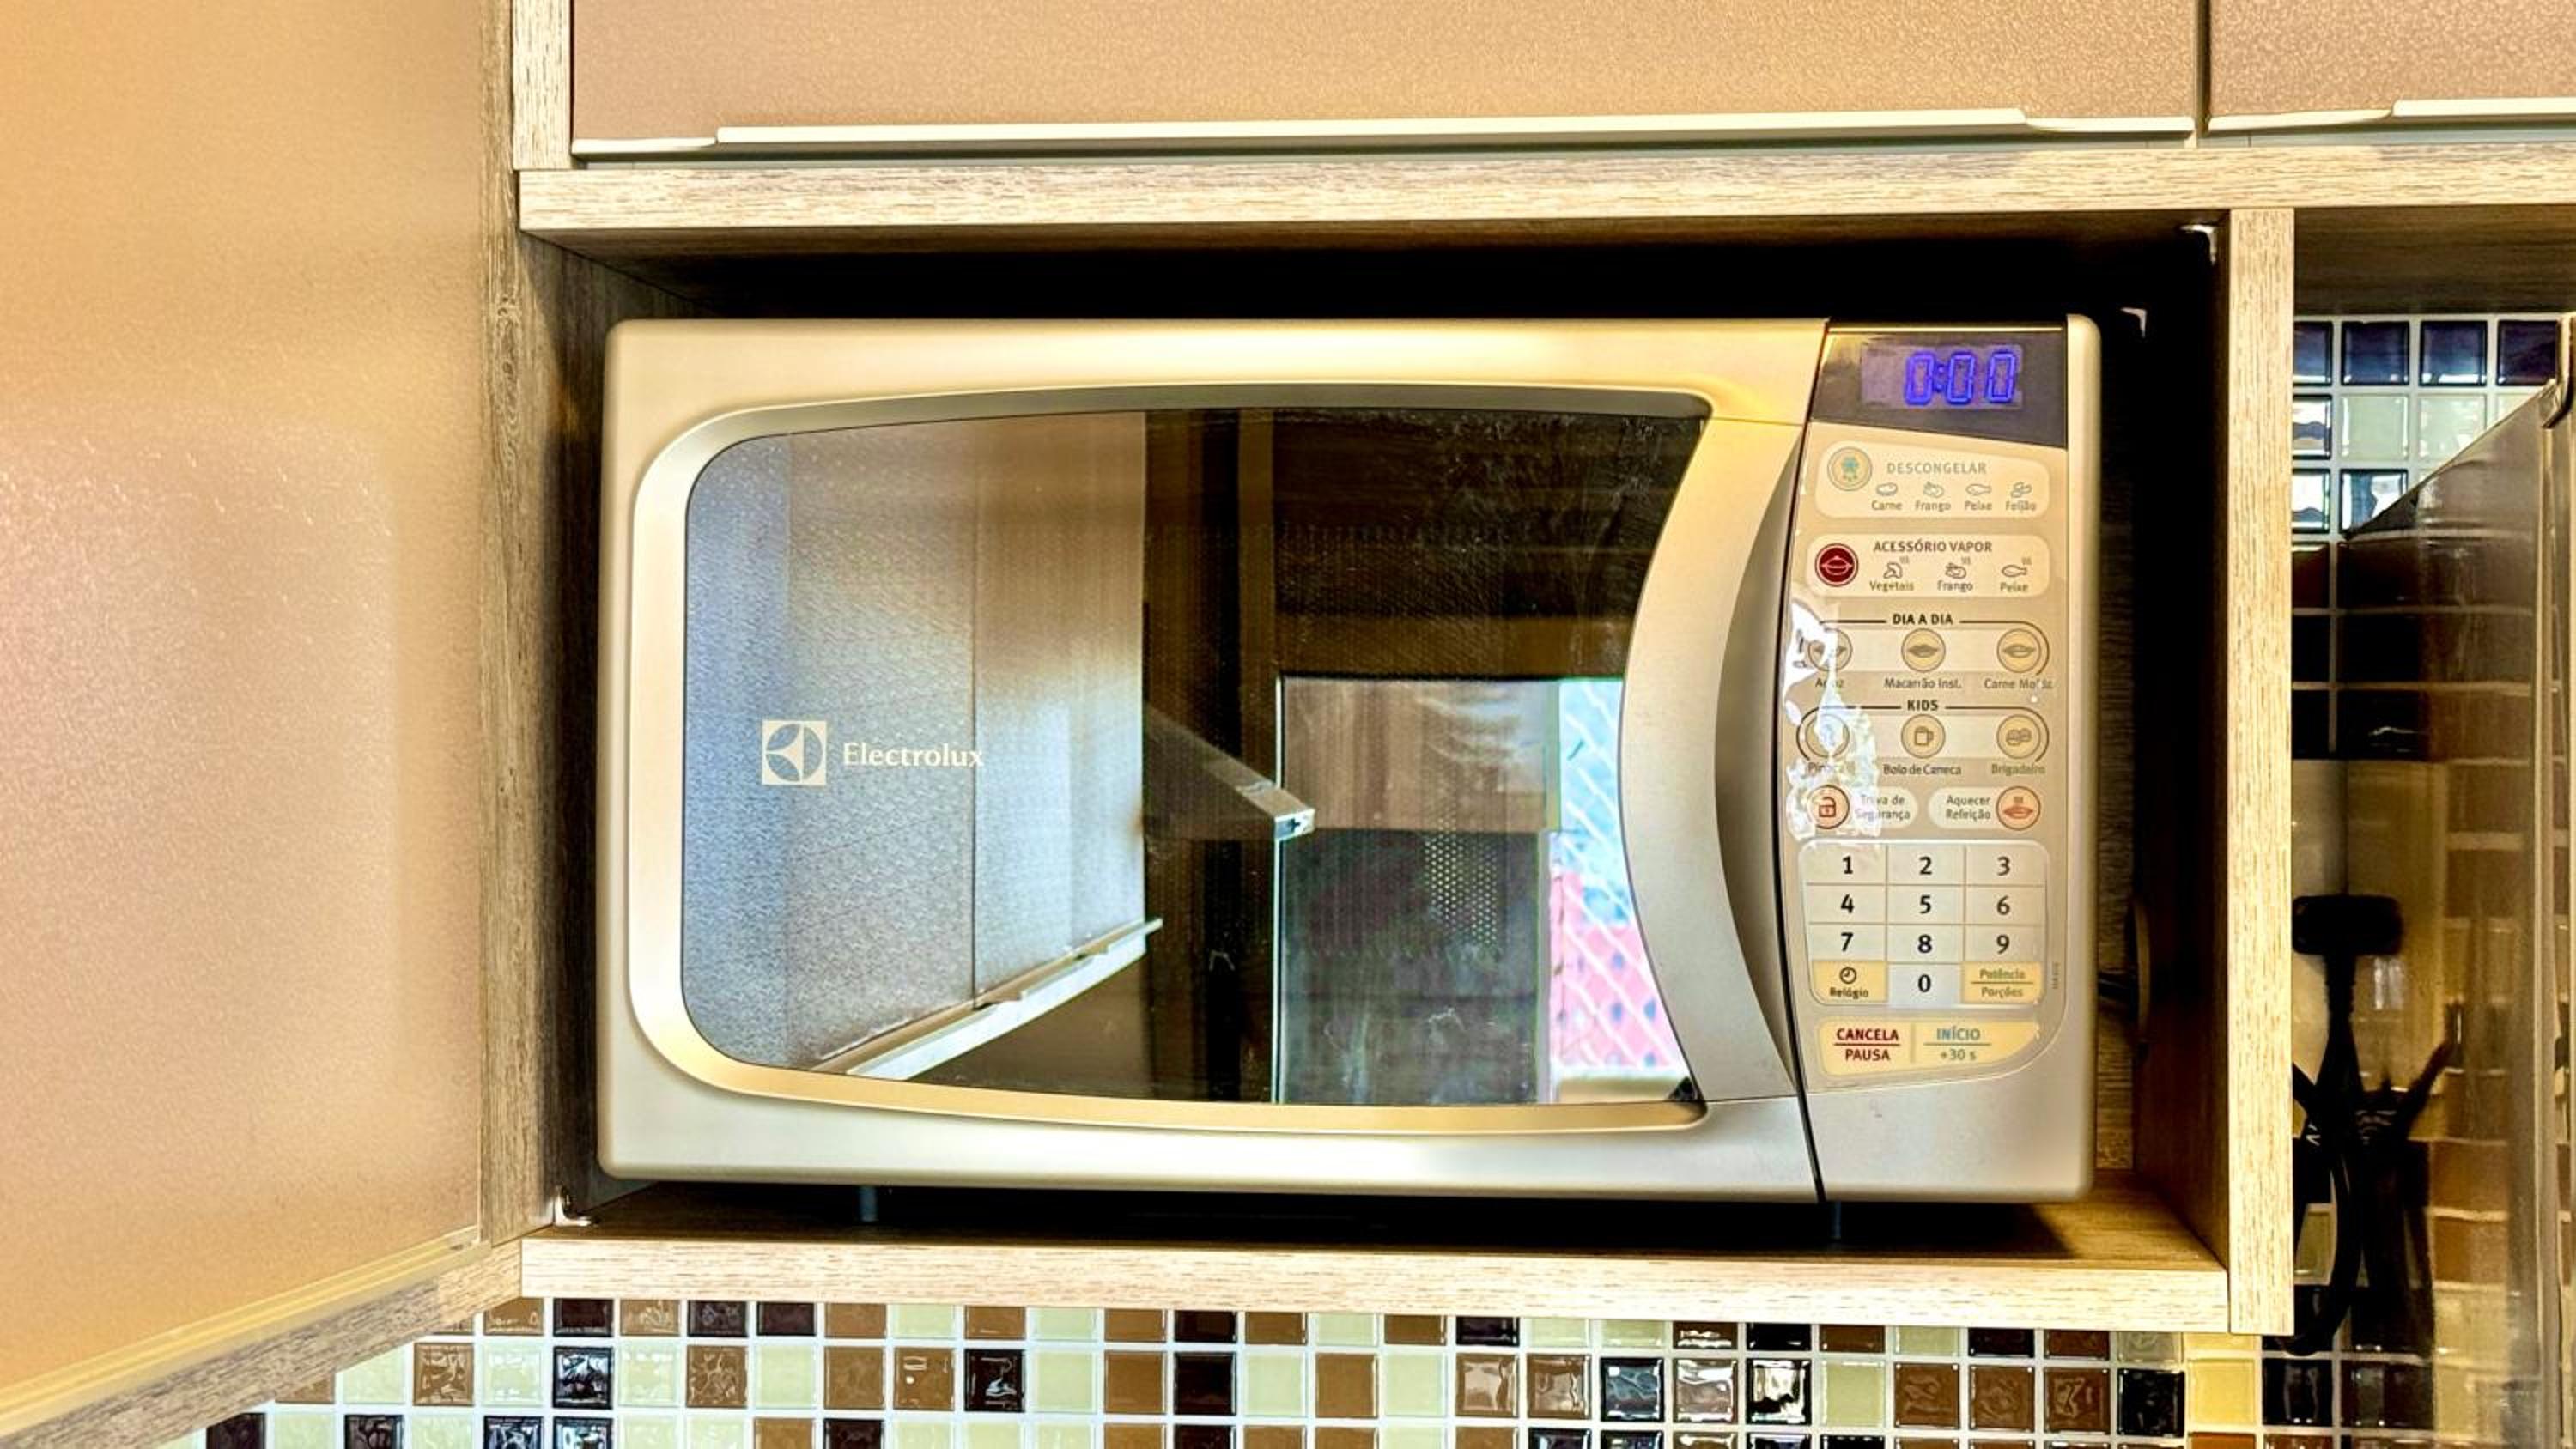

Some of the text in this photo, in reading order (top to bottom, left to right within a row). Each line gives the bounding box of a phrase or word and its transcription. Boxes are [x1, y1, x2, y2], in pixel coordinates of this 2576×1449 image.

[1905, 351, 2016, 405] 0:00
[1886, 462, 1987, 475] DESCONGELAR
[1871, 500, 1903, 511] Carne
[1915, 500, 1952, 512] Frango
[1965, 500, 1992, 511] Peixe
[2005, 500, 2037, 513] Feijão
[1873, 538, 1993, 552] ACESSÓRIO VAPOR
[1869, 580, 1914, 592] Vegetais
[1937, 580, 1973, 592] Frango
[2000, 582, 2028, 591] Peixe
[1893, 613, 1953, 625] DIA A DIA
[1884, 677, 1935, 688] Macarrão
[1984, 678, 2015, 689] Carne
[1907, 700, 1939, 712] KIDS
[843, 743, 984, 767] Electrolux
[1883, 763, 1962, 775] Bolo de Caneca
[1861, 795, 1905, 805] Trva de
[1947, 796, 1990, 807] Aquecer
[1946, 808, 1991, 822] Refeição
[1842, 856, 1854, 875] 1
[1919, 857, 1932, 876] 2
[1996, 857, 2010, 876] 3
[1840, 894, 1854, 914] 4
[1919, 895, 1932, 915] 5
[1996, 895, 2010, 915] 6
[1840, 932, 1854, 951] 7
[1919, 933, 1932, 954] 8
[1996, 933, 2010, 954] 9
[1979, 968, 2026, 980] Potência
[1917, 974, 1931, 993] 0
[1830, 986, 1869, 999] Relógio
[1981, 986, 2024, 998] Porções
[1836, 1028, 1899, 1041] CANCELA
[1936, 1027, 1981, 1040] INÍCIO
[1845, 1049, 1891, 1061] PAUSA
[1940, 1049, 1977, 1061] +30 s
